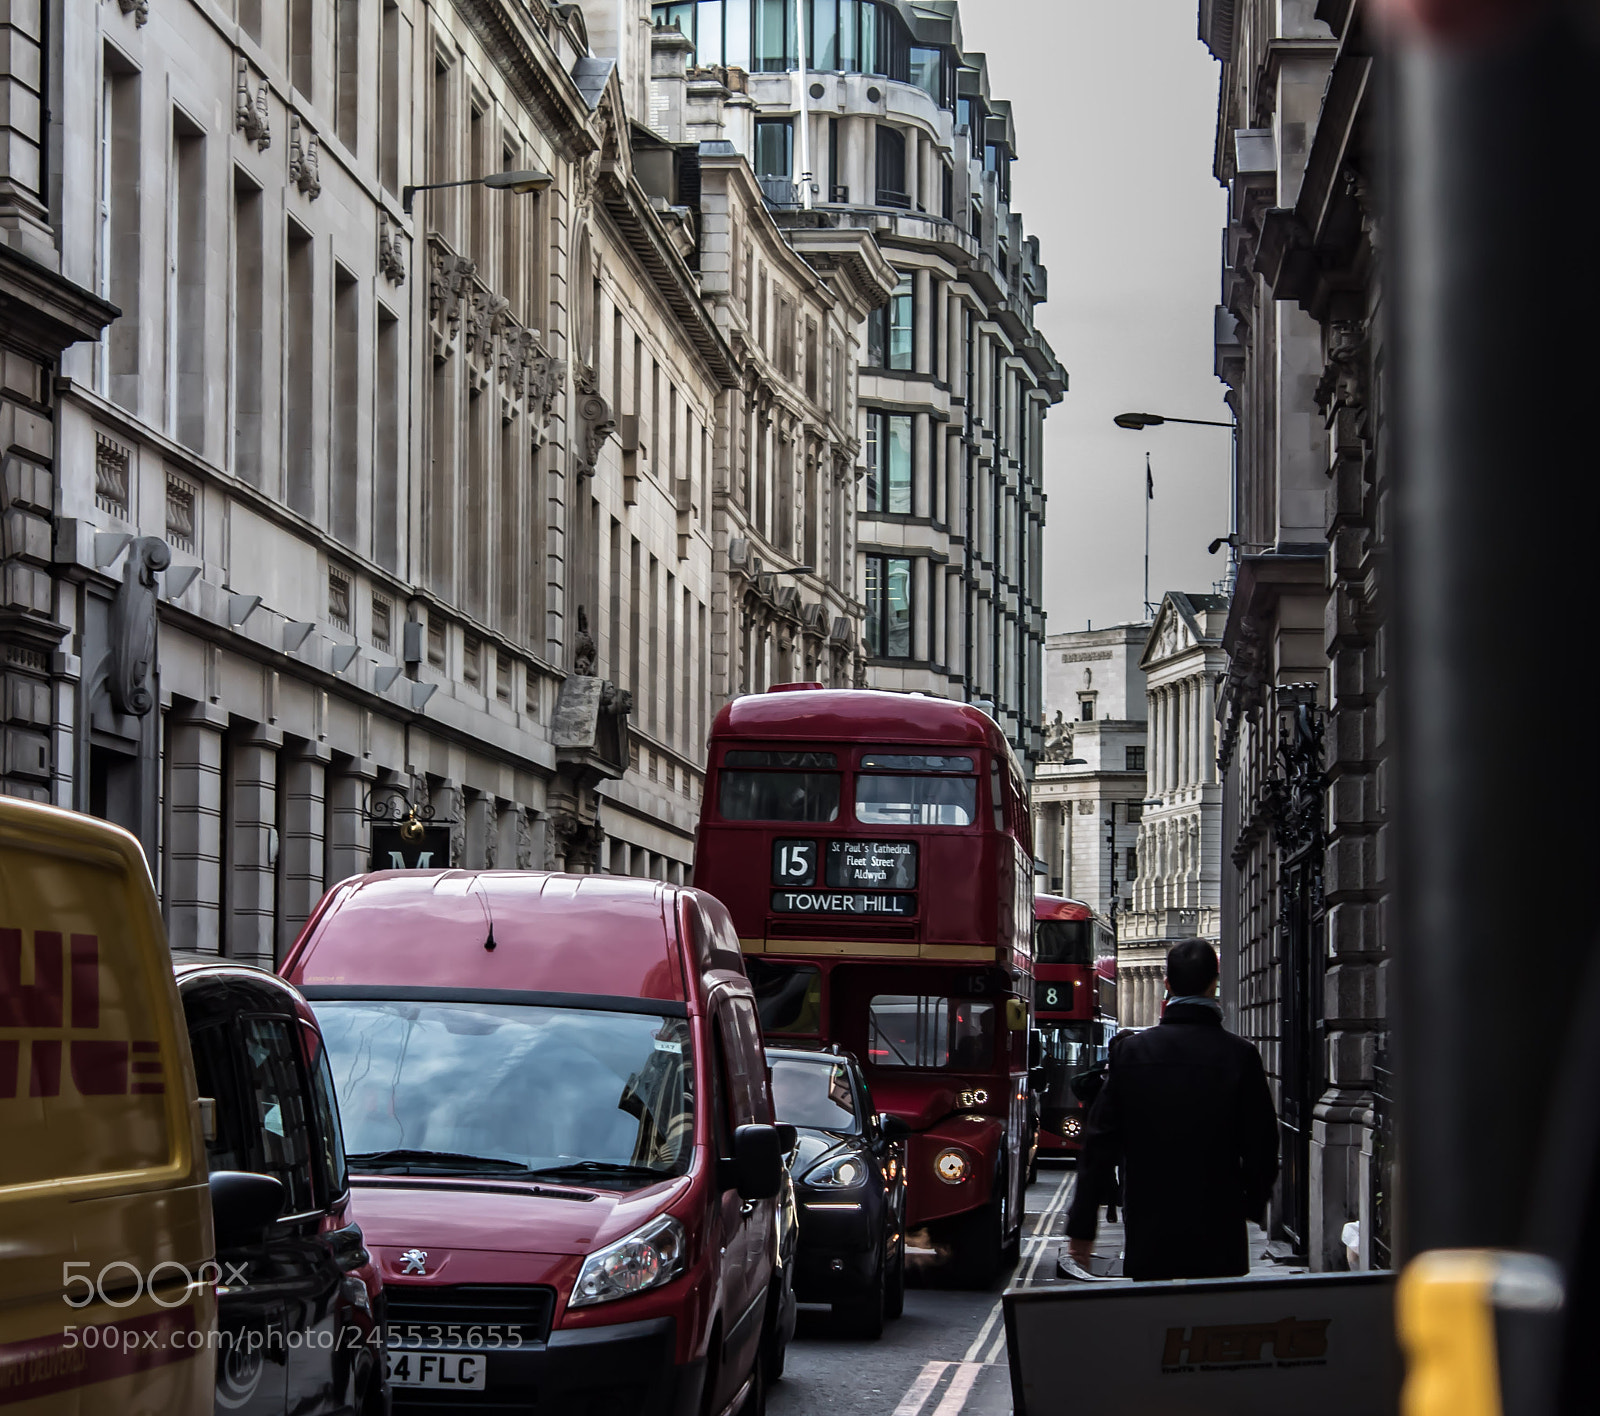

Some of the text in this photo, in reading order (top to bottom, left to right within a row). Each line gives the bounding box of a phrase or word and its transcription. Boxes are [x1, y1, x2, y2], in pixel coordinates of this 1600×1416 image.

[831, 843, 911, 855] St Paul's Cathedral
[781, 846, 809, 876] 15
[846, 856, 895, 867] Fleet Street
[854, 869, 887, 882] Aldwych
[785, 894, 904, 912] TOWER HILL
[968, 976, 985, 993] 15
[1046, 987, 1058, 1005] 8
[1161, 1316, 1332, 1365] Herts
[419, 1356, 475, 1383] FLC
